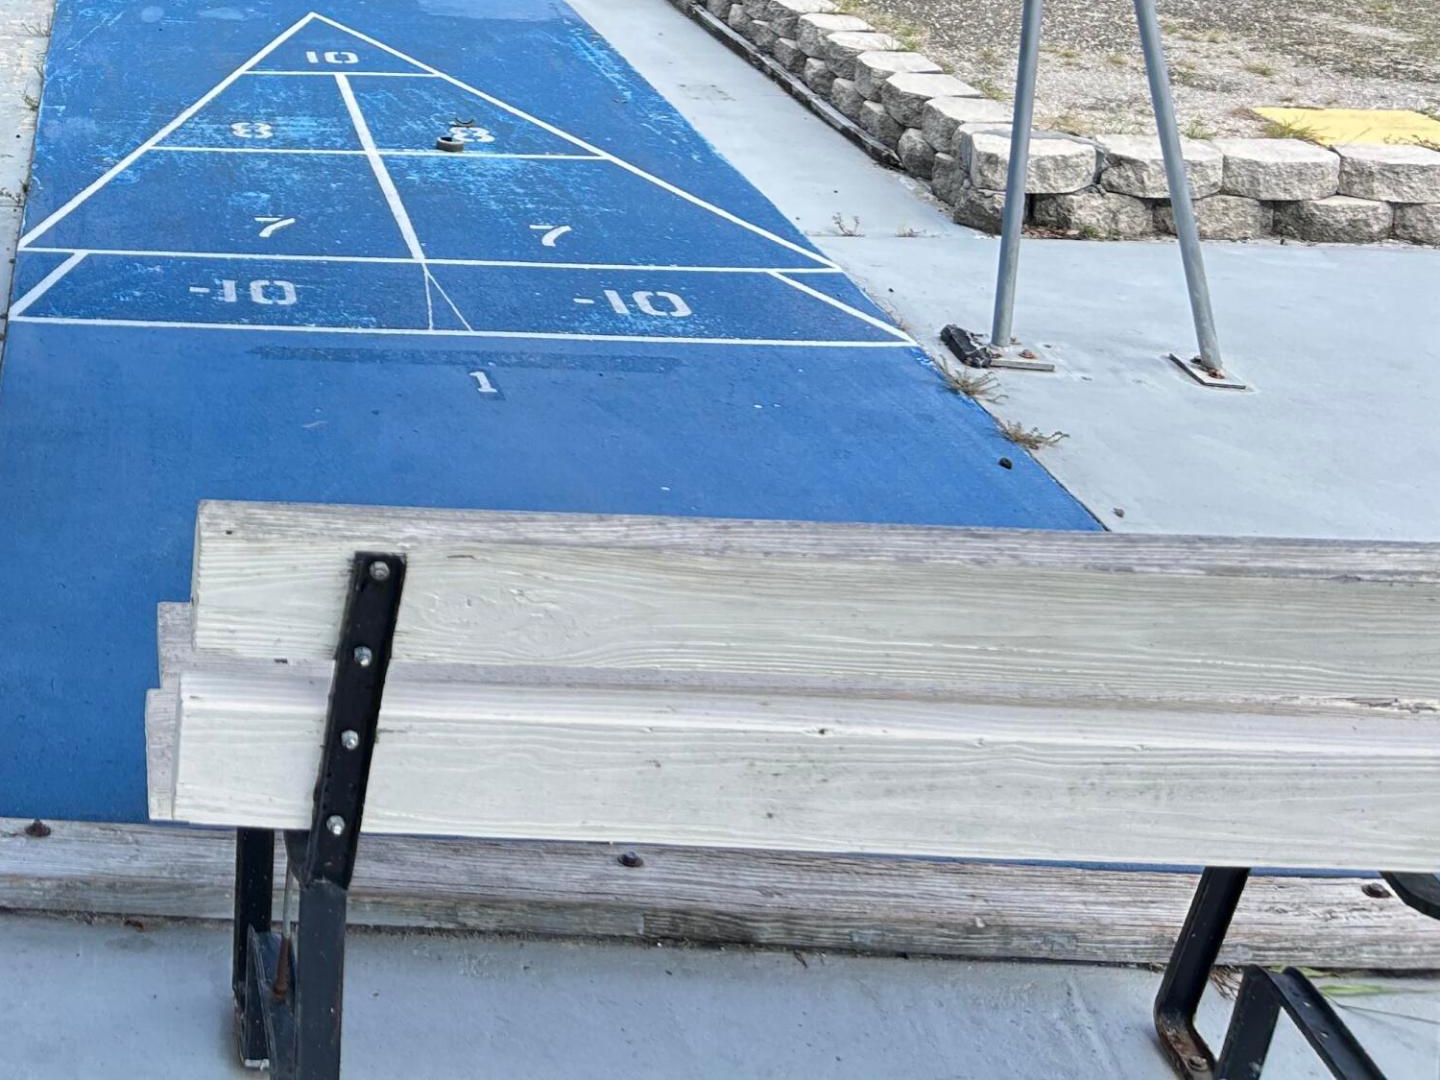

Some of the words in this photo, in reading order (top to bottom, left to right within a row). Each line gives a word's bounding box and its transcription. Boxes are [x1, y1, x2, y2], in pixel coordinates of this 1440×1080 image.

[307, 52, 358, 63] 10
[232, 123, 272, 138] 8
[450, 127, 494, 144] 8
[255, 218, 295, 237] 7
[530, 225, 571, 246] 7
[190, 280, 296, 305] -10
[574, 290, 692, 316] -10
[471, 372, 497, 392] 1
